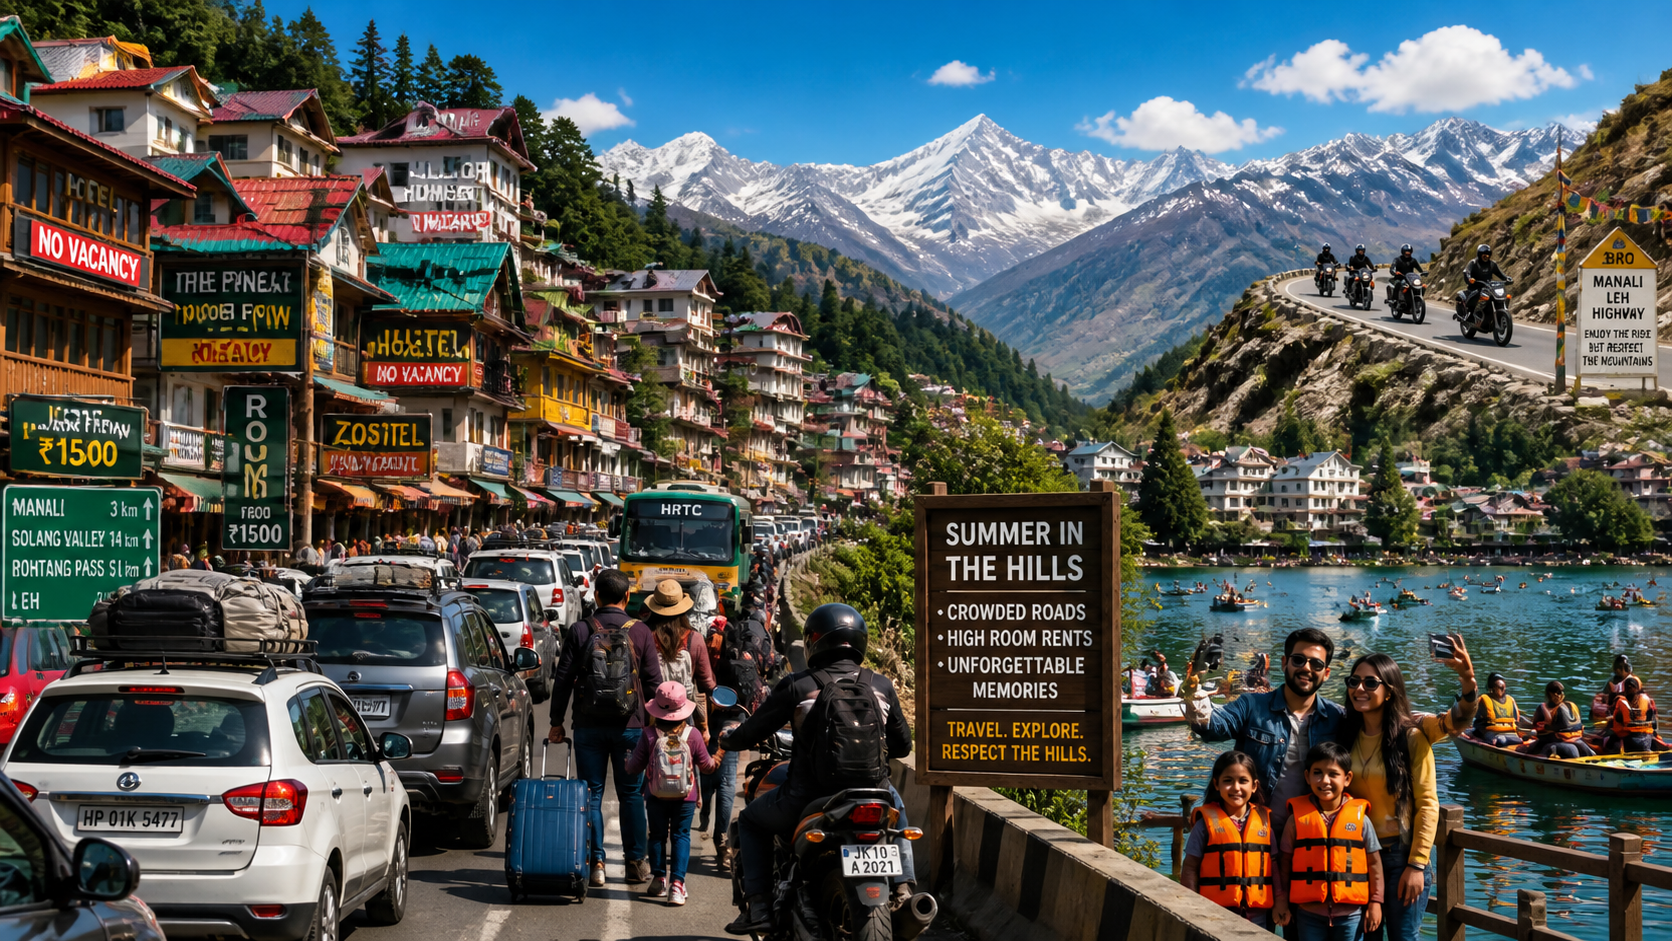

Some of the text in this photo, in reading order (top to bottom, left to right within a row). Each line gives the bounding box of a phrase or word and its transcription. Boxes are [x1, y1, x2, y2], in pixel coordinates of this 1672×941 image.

[39, 226, 139, 281] NO VACANCY
[1593, 275, 1643, 288] MANALI
[1607, 292, 1630, 304] LEH
[38, 436, 118, 468] ₹1500
[12, 497, 138, 517] MANALI 3 km
[660, 503, 702, 516] HRTC
[11, 529, 61, 547] SOLANG
[64, 530, 106, 548] VALLEY
[109, 530, 122, 548] 14
[228, 523, 282, 544] ₹1500
[945, 520, 1083, 547] SUMMER IN
[75, 559, 105, 577] PASS
[945, 554, 1084, 582] THE HILLS
[947, 603, 1086, 621] CROWDED ROADS
[947, 629, 1093, 647] HIGH ROOM RENTS
[947, 656, 1085, 675] UNFORGETTABLE
[972, 681, 1059, 699] MEMORIES
[947, 721, 1084, 740] TRAVEL. EXPLORE.
[942, 743, 1092, 763] RESPECT THE HILLS.
[82, 810, 179, 829] HP 01K 5477
[854, 846, 871, 860] JK
[873, 846, 888, 860] 10
[851, 860, 894, 874] A 2021
